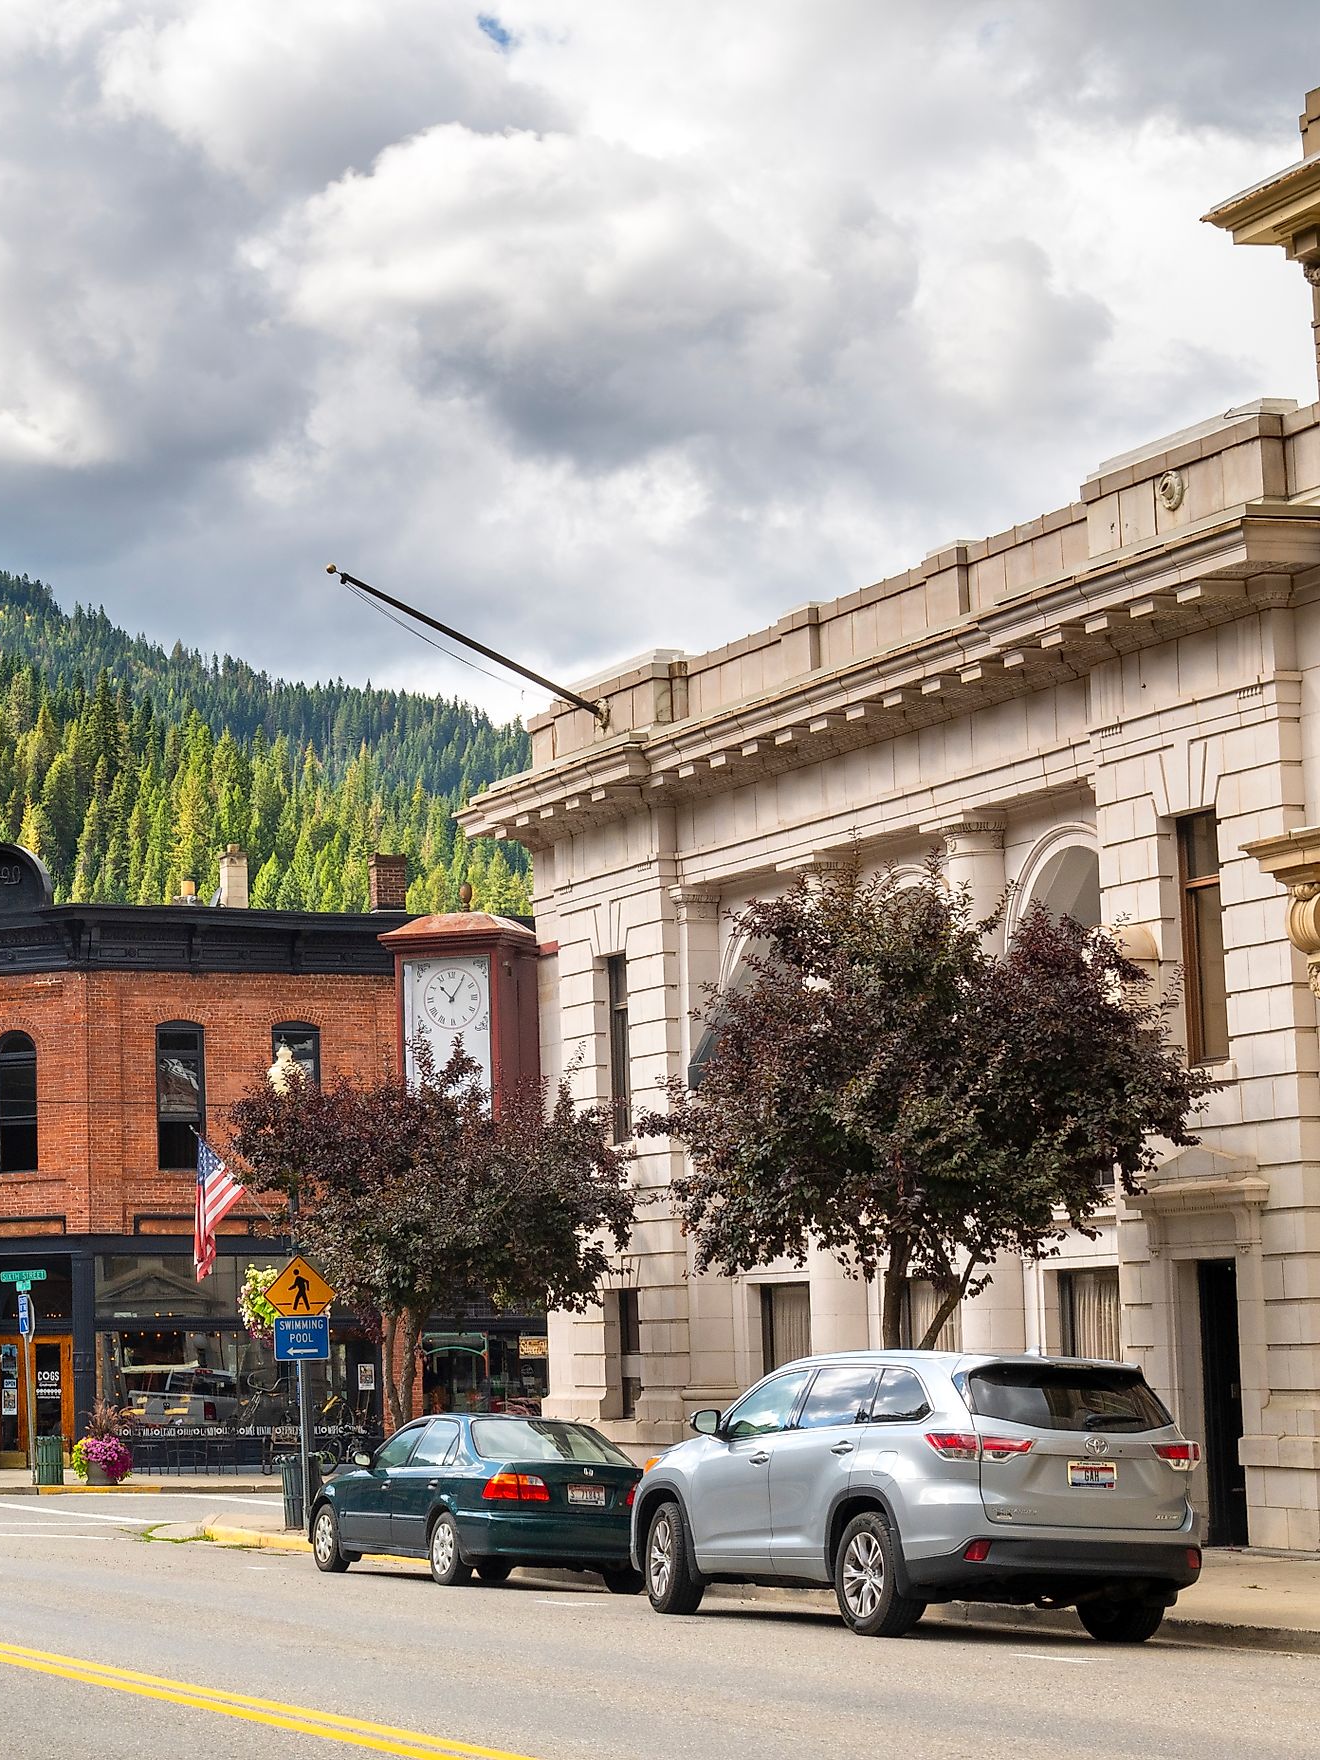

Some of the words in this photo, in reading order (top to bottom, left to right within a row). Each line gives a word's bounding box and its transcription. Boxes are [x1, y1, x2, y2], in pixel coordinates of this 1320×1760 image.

[2, 1272, 20, 1281] SIXTH
[22, 1271, 45, 1280] STREET
[280, 1319, 324, 1330] SWIMMING
[290, 1333, 314, 1343] POOL
[37, 1371, 60, 1381] COGS
[1084, 1469, 1100, 1482] GAH
